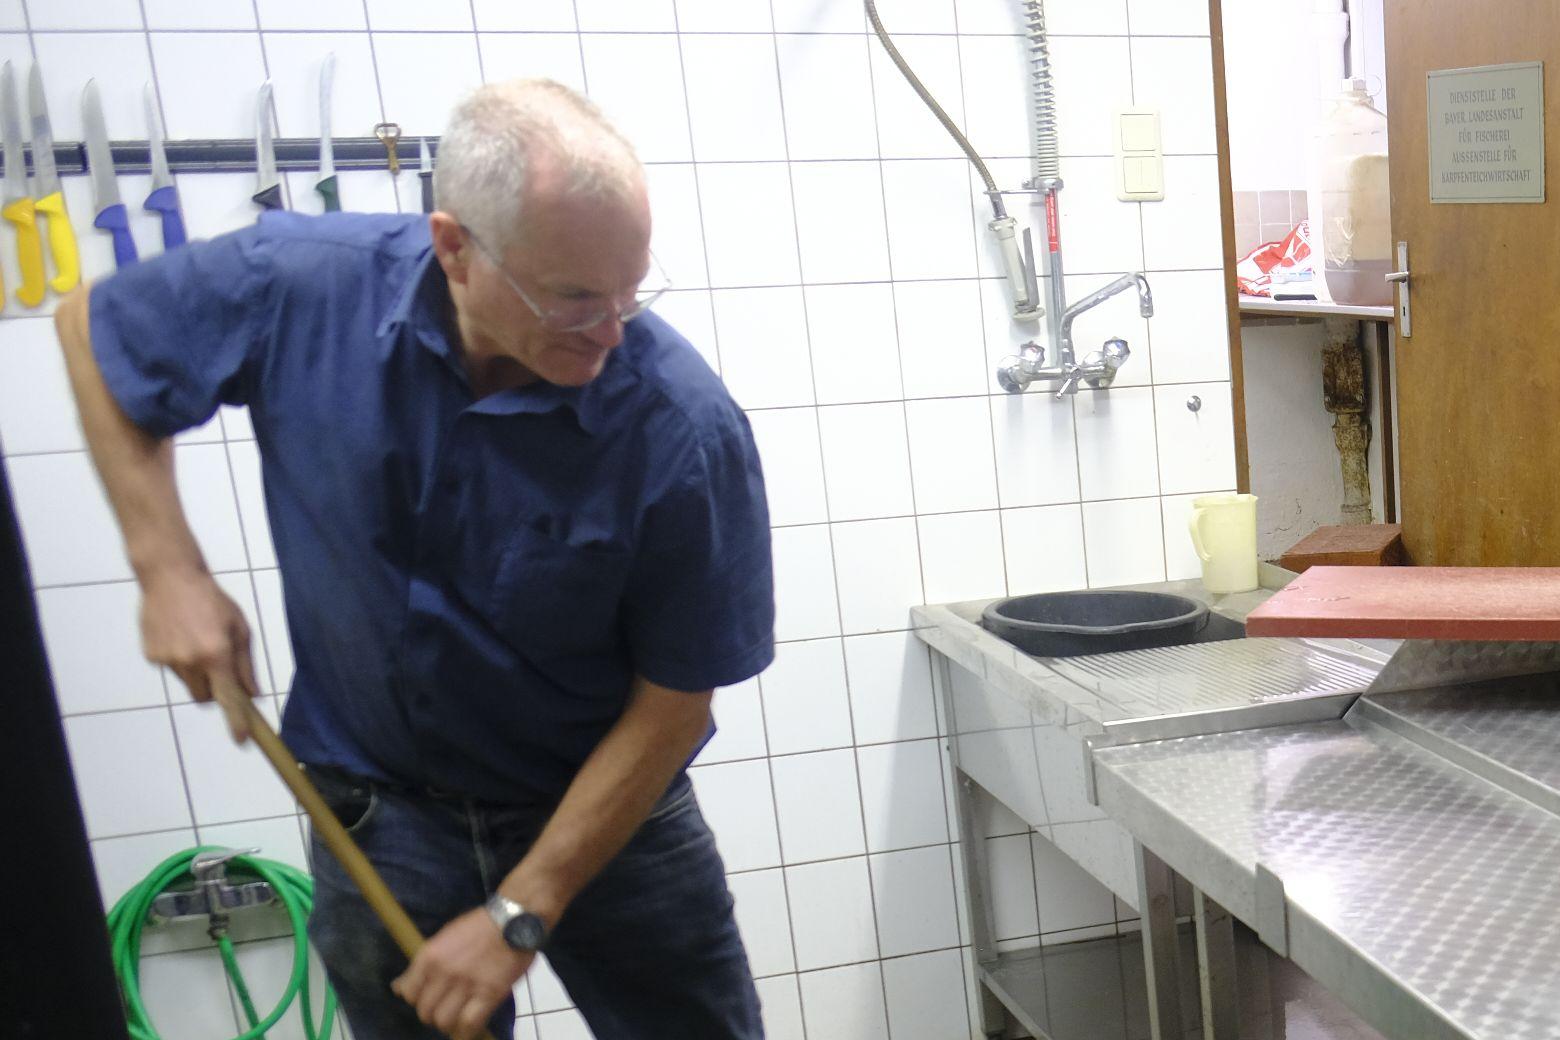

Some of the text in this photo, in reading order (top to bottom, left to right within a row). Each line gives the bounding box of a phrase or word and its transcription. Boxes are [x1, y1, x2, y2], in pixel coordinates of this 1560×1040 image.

[1449, 87, 1517, 104] DIENSTSTELLE DER
[1468, 107, 1524, 123] LANDESANSTALT
[1458, 127, 1510, 143] FÜR FISCHEREI
[1451, 143, 1517, 164] AUSSENSTELLE FÜR
[1441, 169, 1530, 184] KARPFENTEICHWIRTSCHAFT
